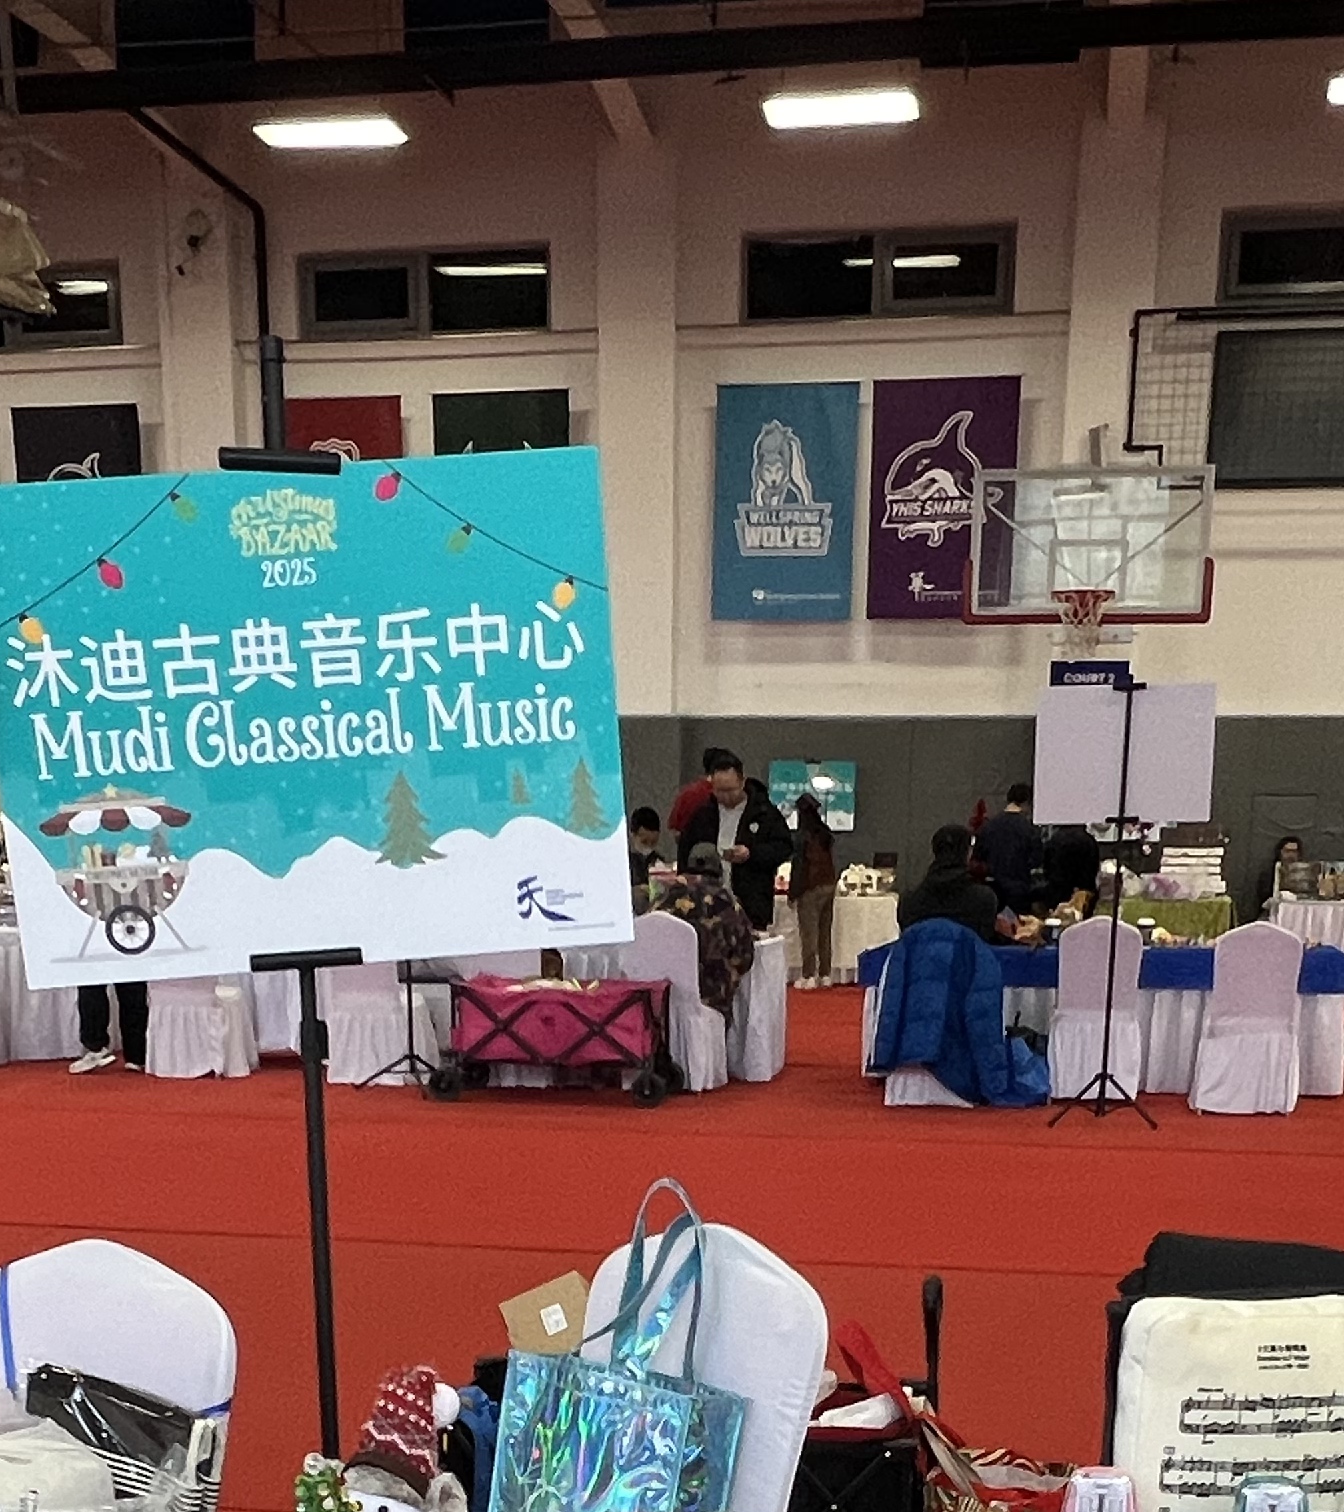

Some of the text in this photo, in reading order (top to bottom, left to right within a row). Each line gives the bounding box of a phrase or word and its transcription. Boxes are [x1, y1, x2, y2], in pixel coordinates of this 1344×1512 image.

[744, 526, 823, 548] WOLVES
[260, 556, 318, 588] 2025
[5, 600, 586, 708] 沐迪古典音乐中心
[30, 681, 578, 781] Mudi Classical Music
